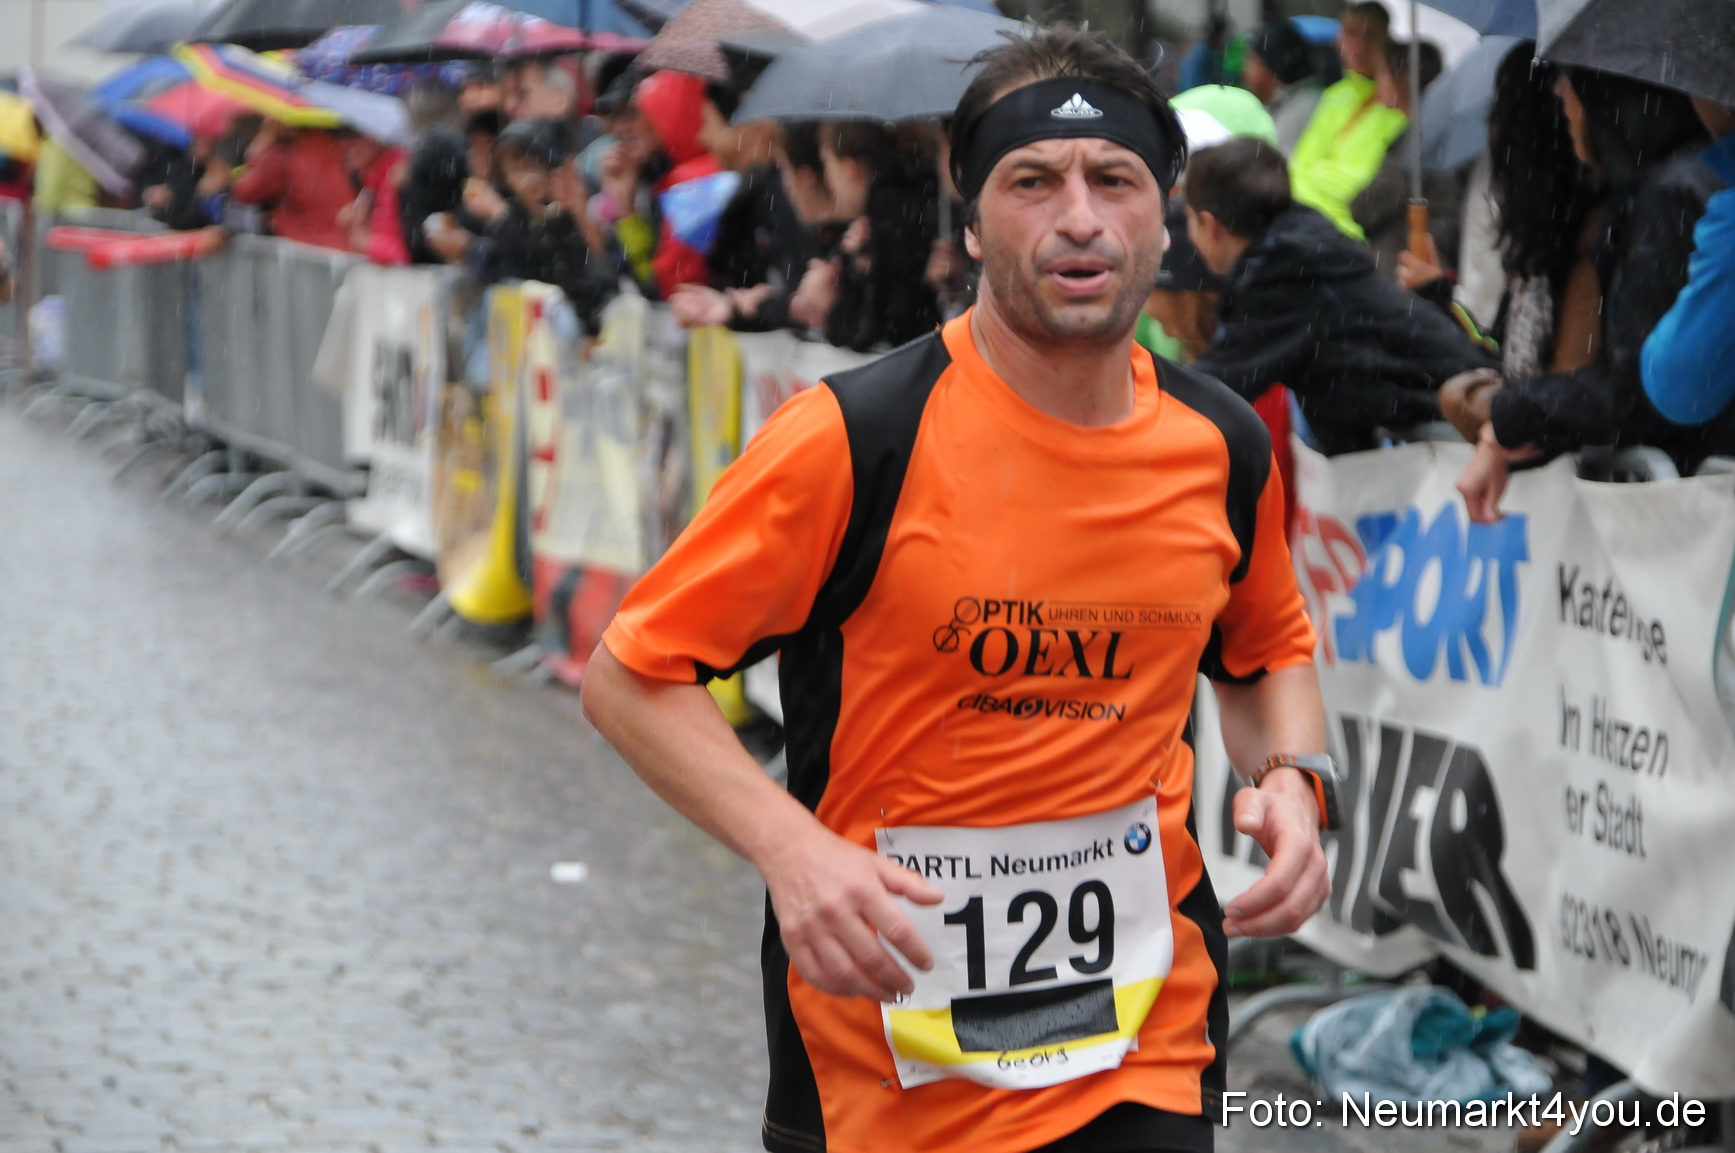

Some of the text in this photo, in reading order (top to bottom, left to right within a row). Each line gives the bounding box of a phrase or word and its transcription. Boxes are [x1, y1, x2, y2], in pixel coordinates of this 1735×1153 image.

[954, 596, 1203, 626] OPTIK UHREN UND SCHMUCK
[969, 626, 1135, 680] OEXL
[1594, 779, 1647, 859] Stadt
[990, 838, 1115, 877] Neumarkt
[944, 879, 1115, 991] 129
